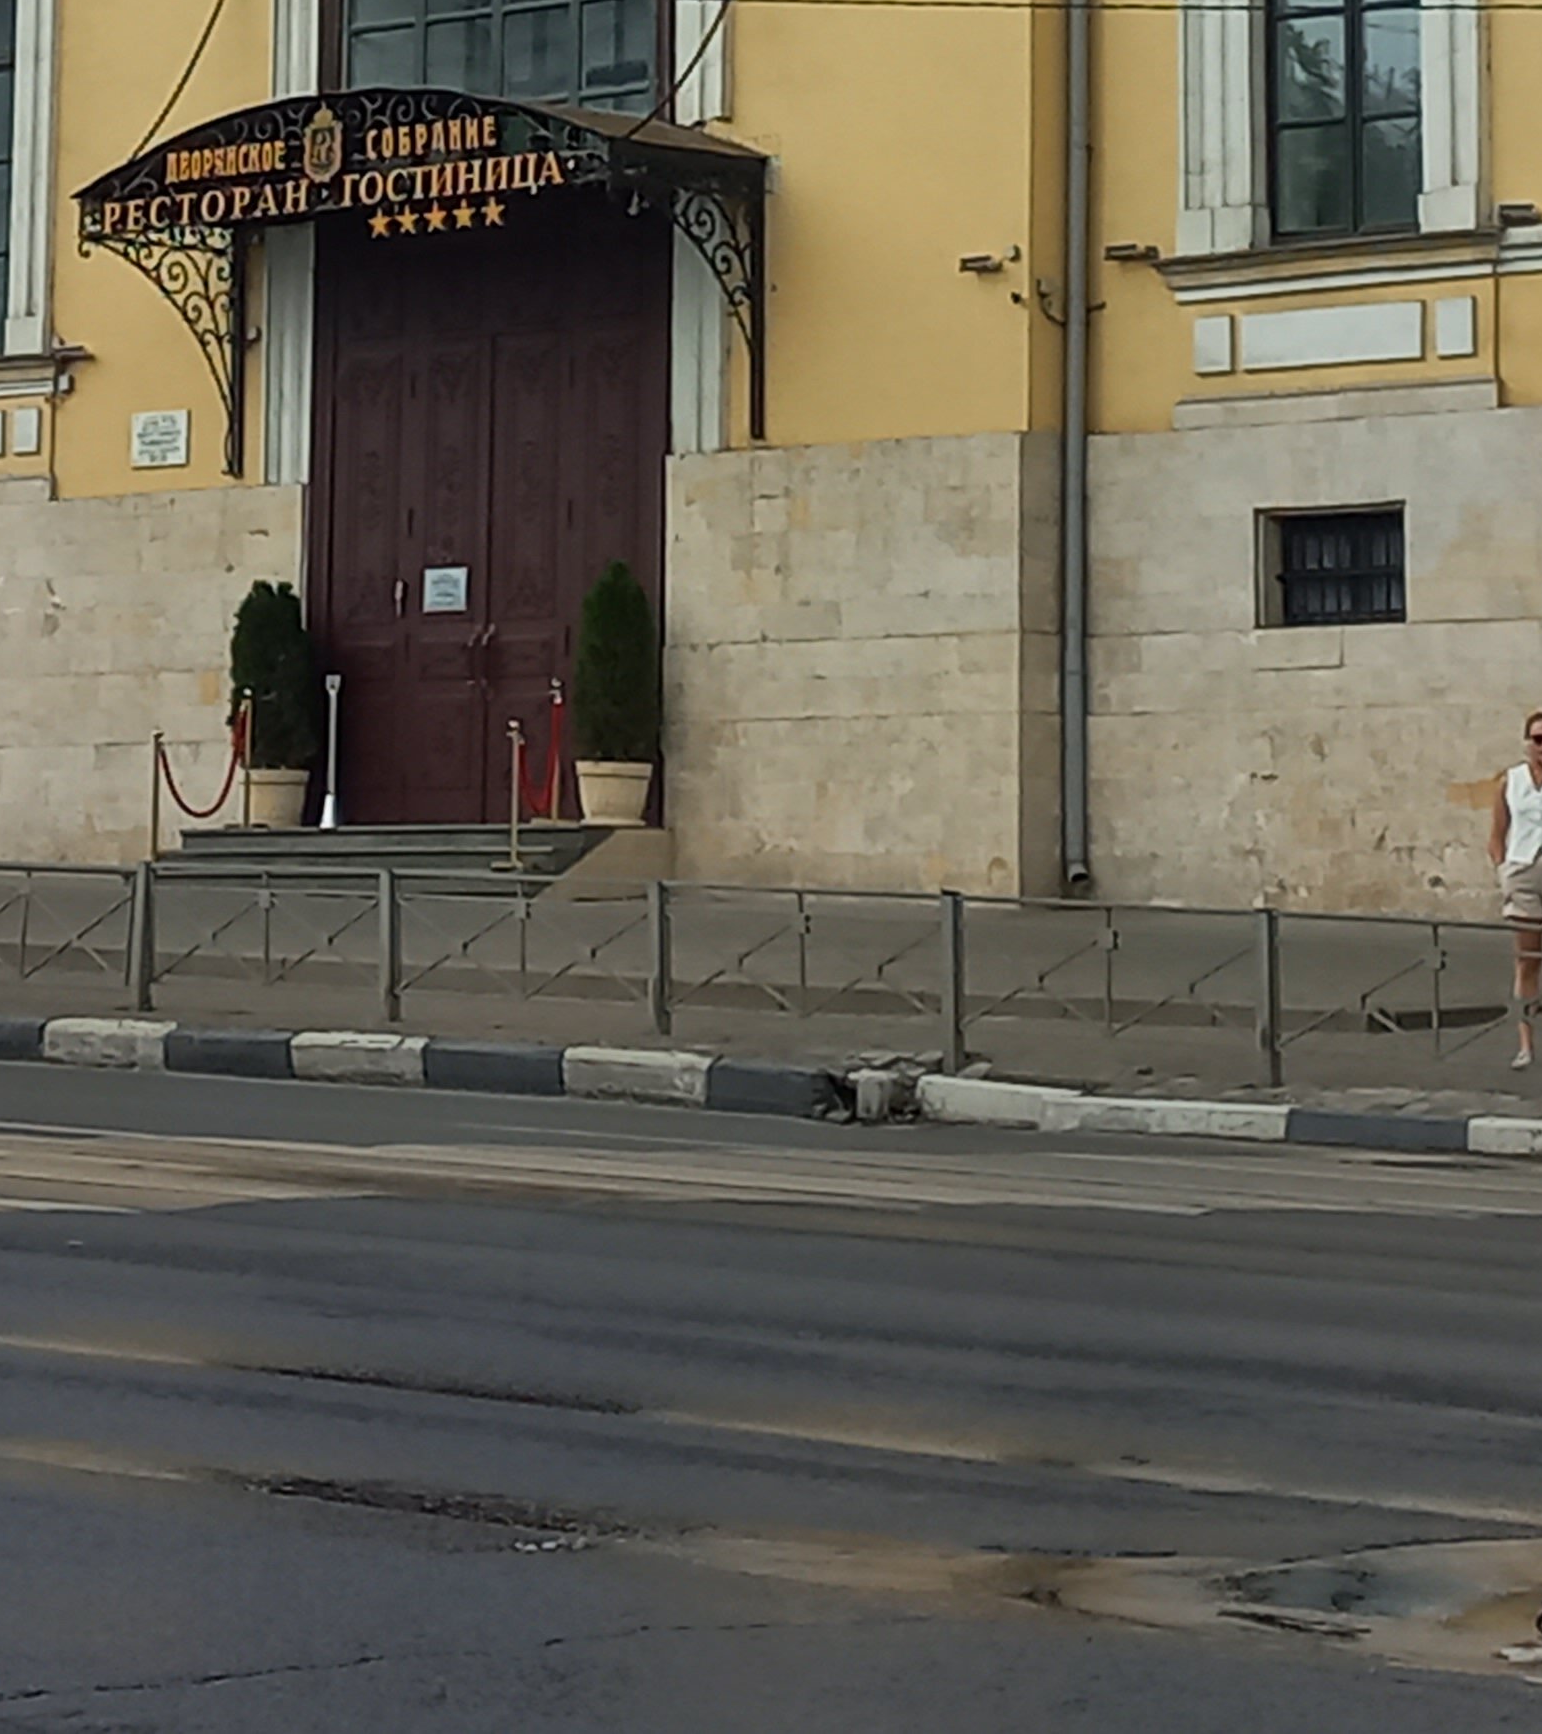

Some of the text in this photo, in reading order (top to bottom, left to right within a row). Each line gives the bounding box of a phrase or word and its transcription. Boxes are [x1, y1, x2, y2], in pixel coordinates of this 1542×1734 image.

[164, 114, 498, 185] ДВОРЯНСКОЕ СОБРАНИЕ
[102, 149, 566, 234] РЕСТОРАН ГОСТИНИЦА
